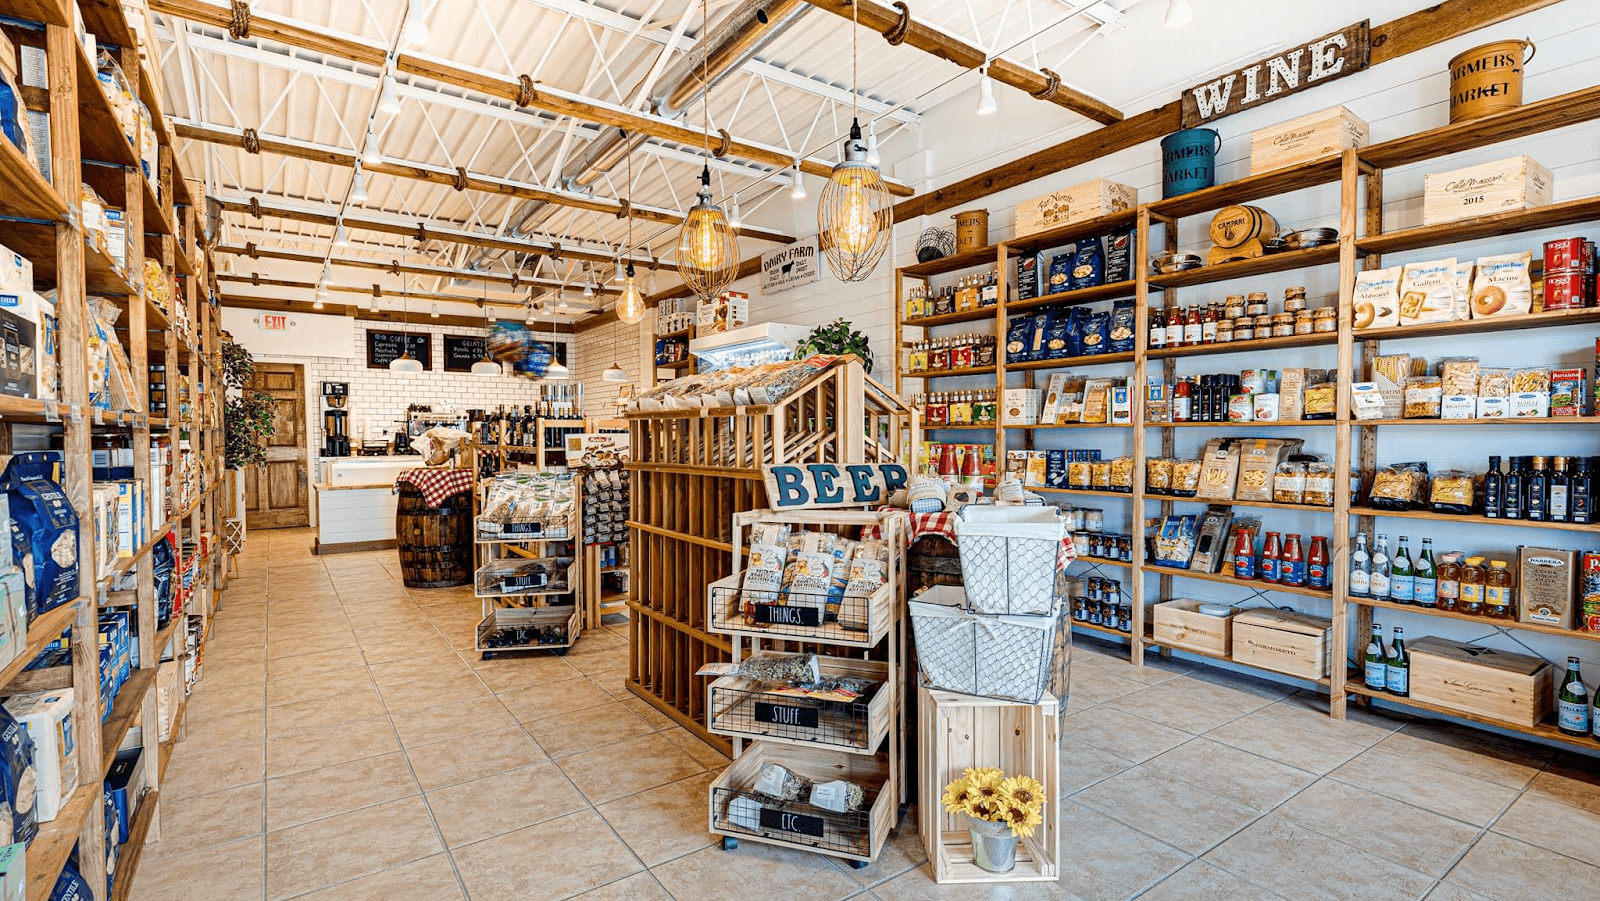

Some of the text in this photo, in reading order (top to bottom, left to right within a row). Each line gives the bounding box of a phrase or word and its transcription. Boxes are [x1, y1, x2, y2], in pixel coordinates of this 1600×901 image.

[1193, 33, 1347, 119] WINE
[1452, 53, 1515, 81] ARMERS
[1164, 145, 1211, 163] ARMERS
[1463, 195, 1485, 206] 2015
[958, 217, 981, 228] MERS
[1218, 218, 1245, 230] CAMPARI
[763, 251, 787, 272] DAIRY
[789, 246, 814, 260] FARM
[265, 315, 287, 329] EXIT
[771, 462, 909, 507] BEER
[1529, 557, 1562, 566] BARBERA
[768, 606, 804, 625] THINGS.
[772, 706, 800, 725] STUFF.
[781, 813, 801, 832] ETC.
